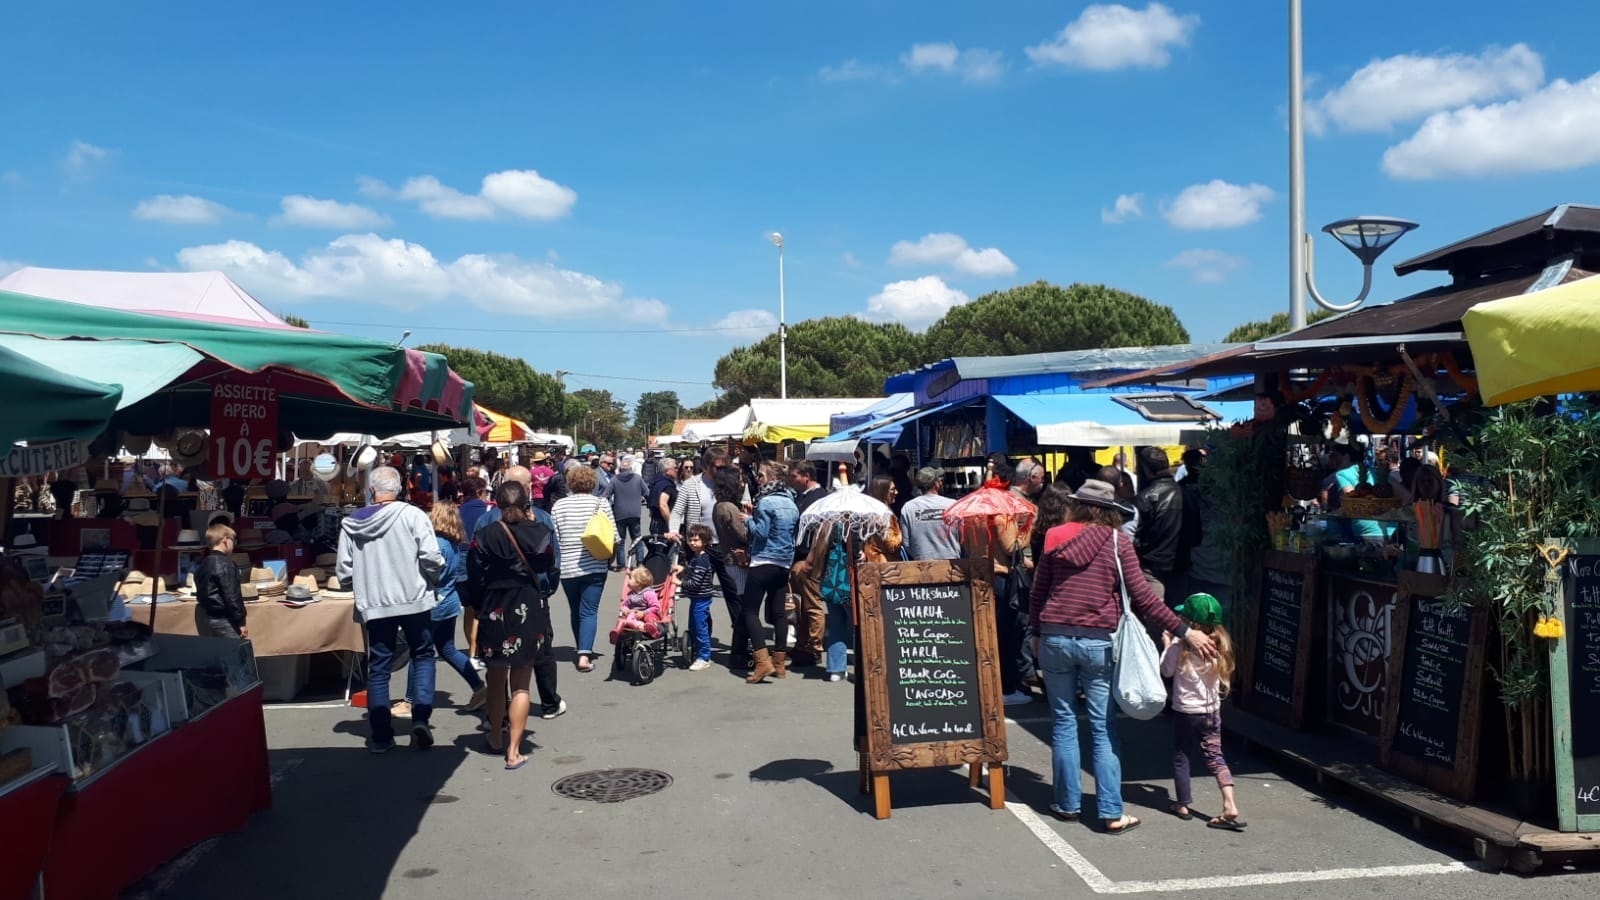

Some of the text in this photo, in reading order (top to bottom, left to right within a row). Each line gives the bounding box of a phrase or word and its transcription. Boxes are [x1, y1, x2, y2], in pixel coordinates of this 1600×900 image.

[214, 383, 276, 402] ASSIETTE
[223, 403, 267, 419] APERO
[215, 437, 273, 476] 10€
[905, 687, 965, 700] L'AVOCADO
